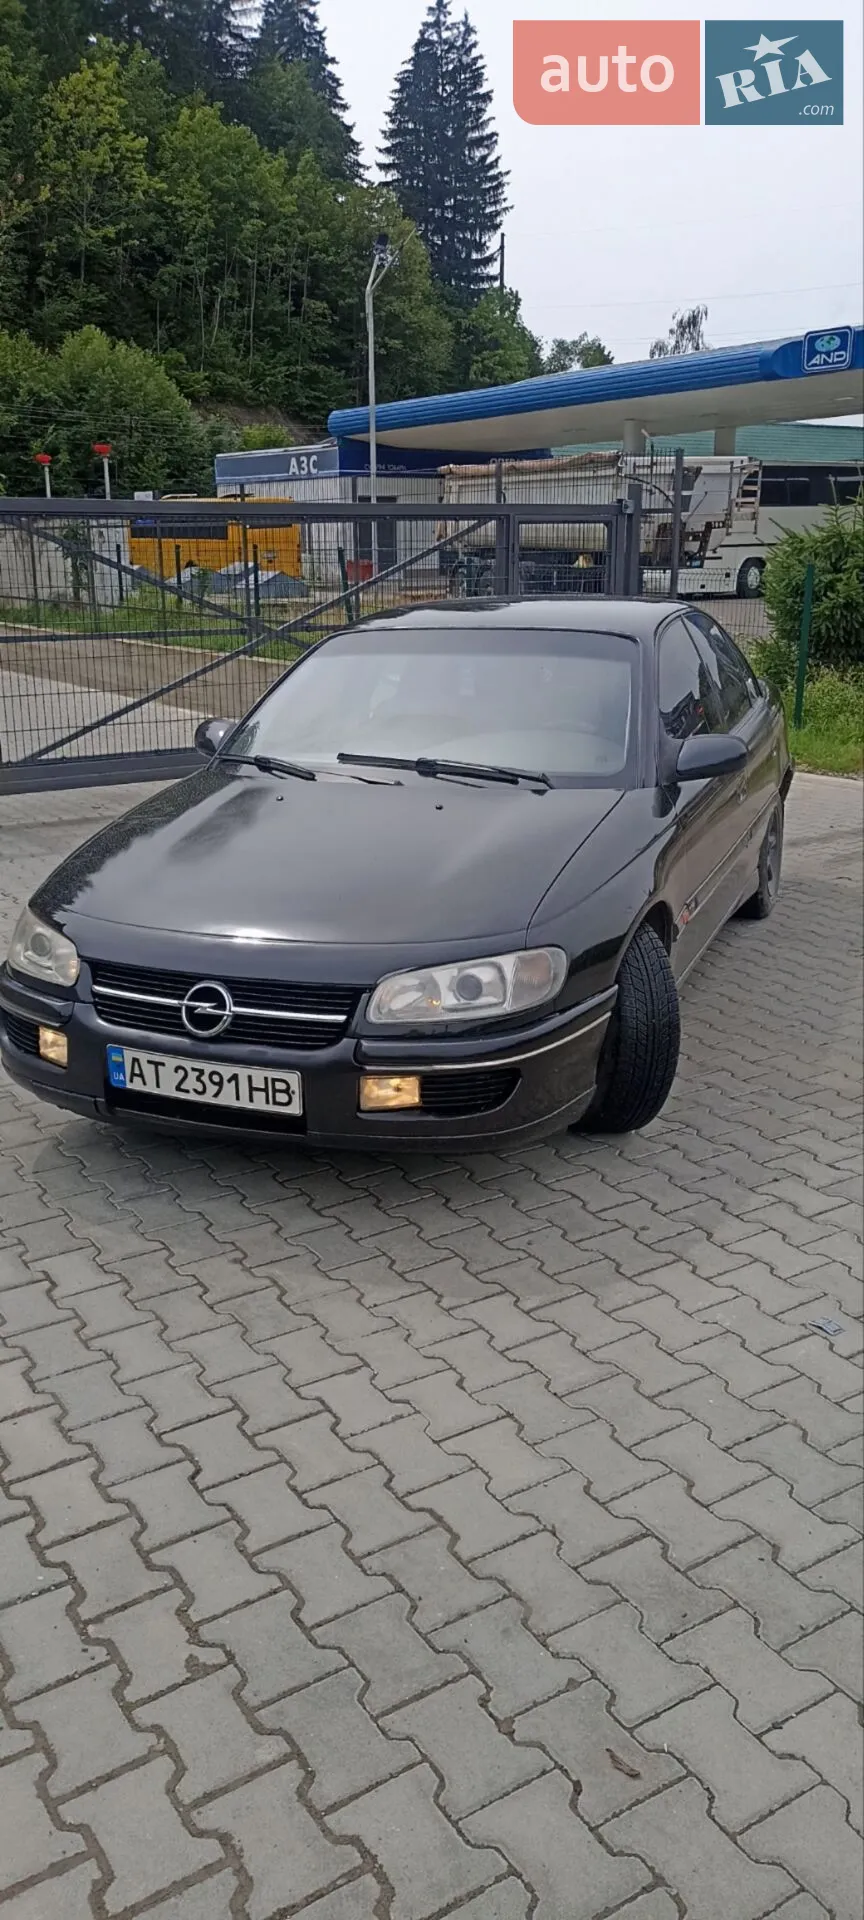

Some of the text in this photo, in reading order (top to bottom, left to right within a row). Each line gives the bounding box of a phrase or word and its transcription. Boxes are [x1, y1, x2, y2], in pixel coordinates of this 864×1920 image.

[807, 350, 846, 366] ANP
[113, 1071, 125, 1081] UA
[129, 1057, 292, 1107] AT 2391 HB
